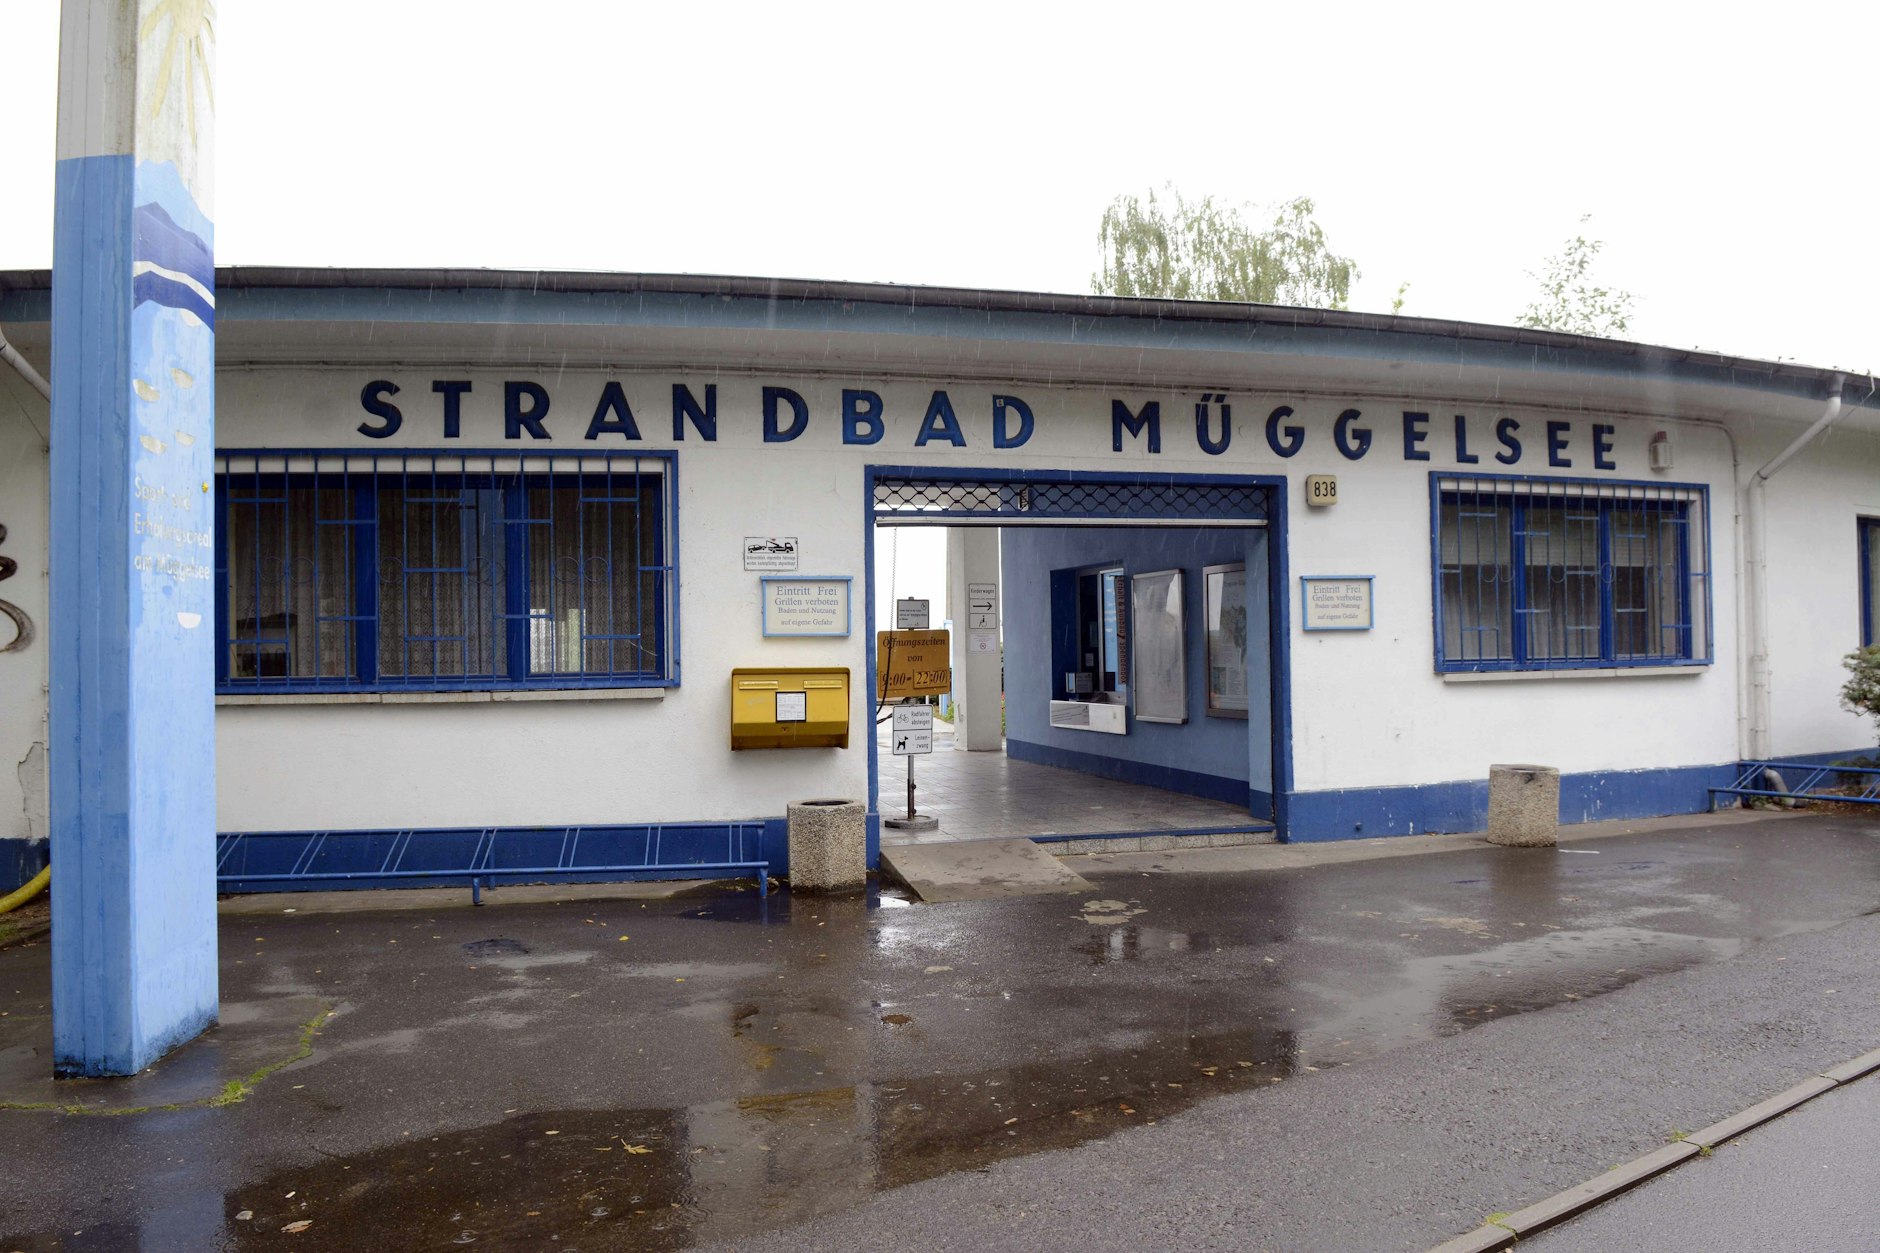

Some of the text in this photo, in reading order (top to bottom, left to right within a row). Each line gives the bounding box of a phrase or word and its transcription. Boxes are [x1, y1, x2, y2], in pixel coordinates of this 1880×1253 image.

[357, 380, 1616, 470] STRANDBAD MÜGGELSEE
[1314, 481, 1337, 497] 838
[776, 586, 837, 596] Eintritt Frei
[1313, 584, 1361, 594] Eintritt Frei
[774, 598, 839, 606] Grillen verboten
[1312, 594, 1363, 602] Grillen verboten
[882, 635, 946, 649] Öffnungszeiten
